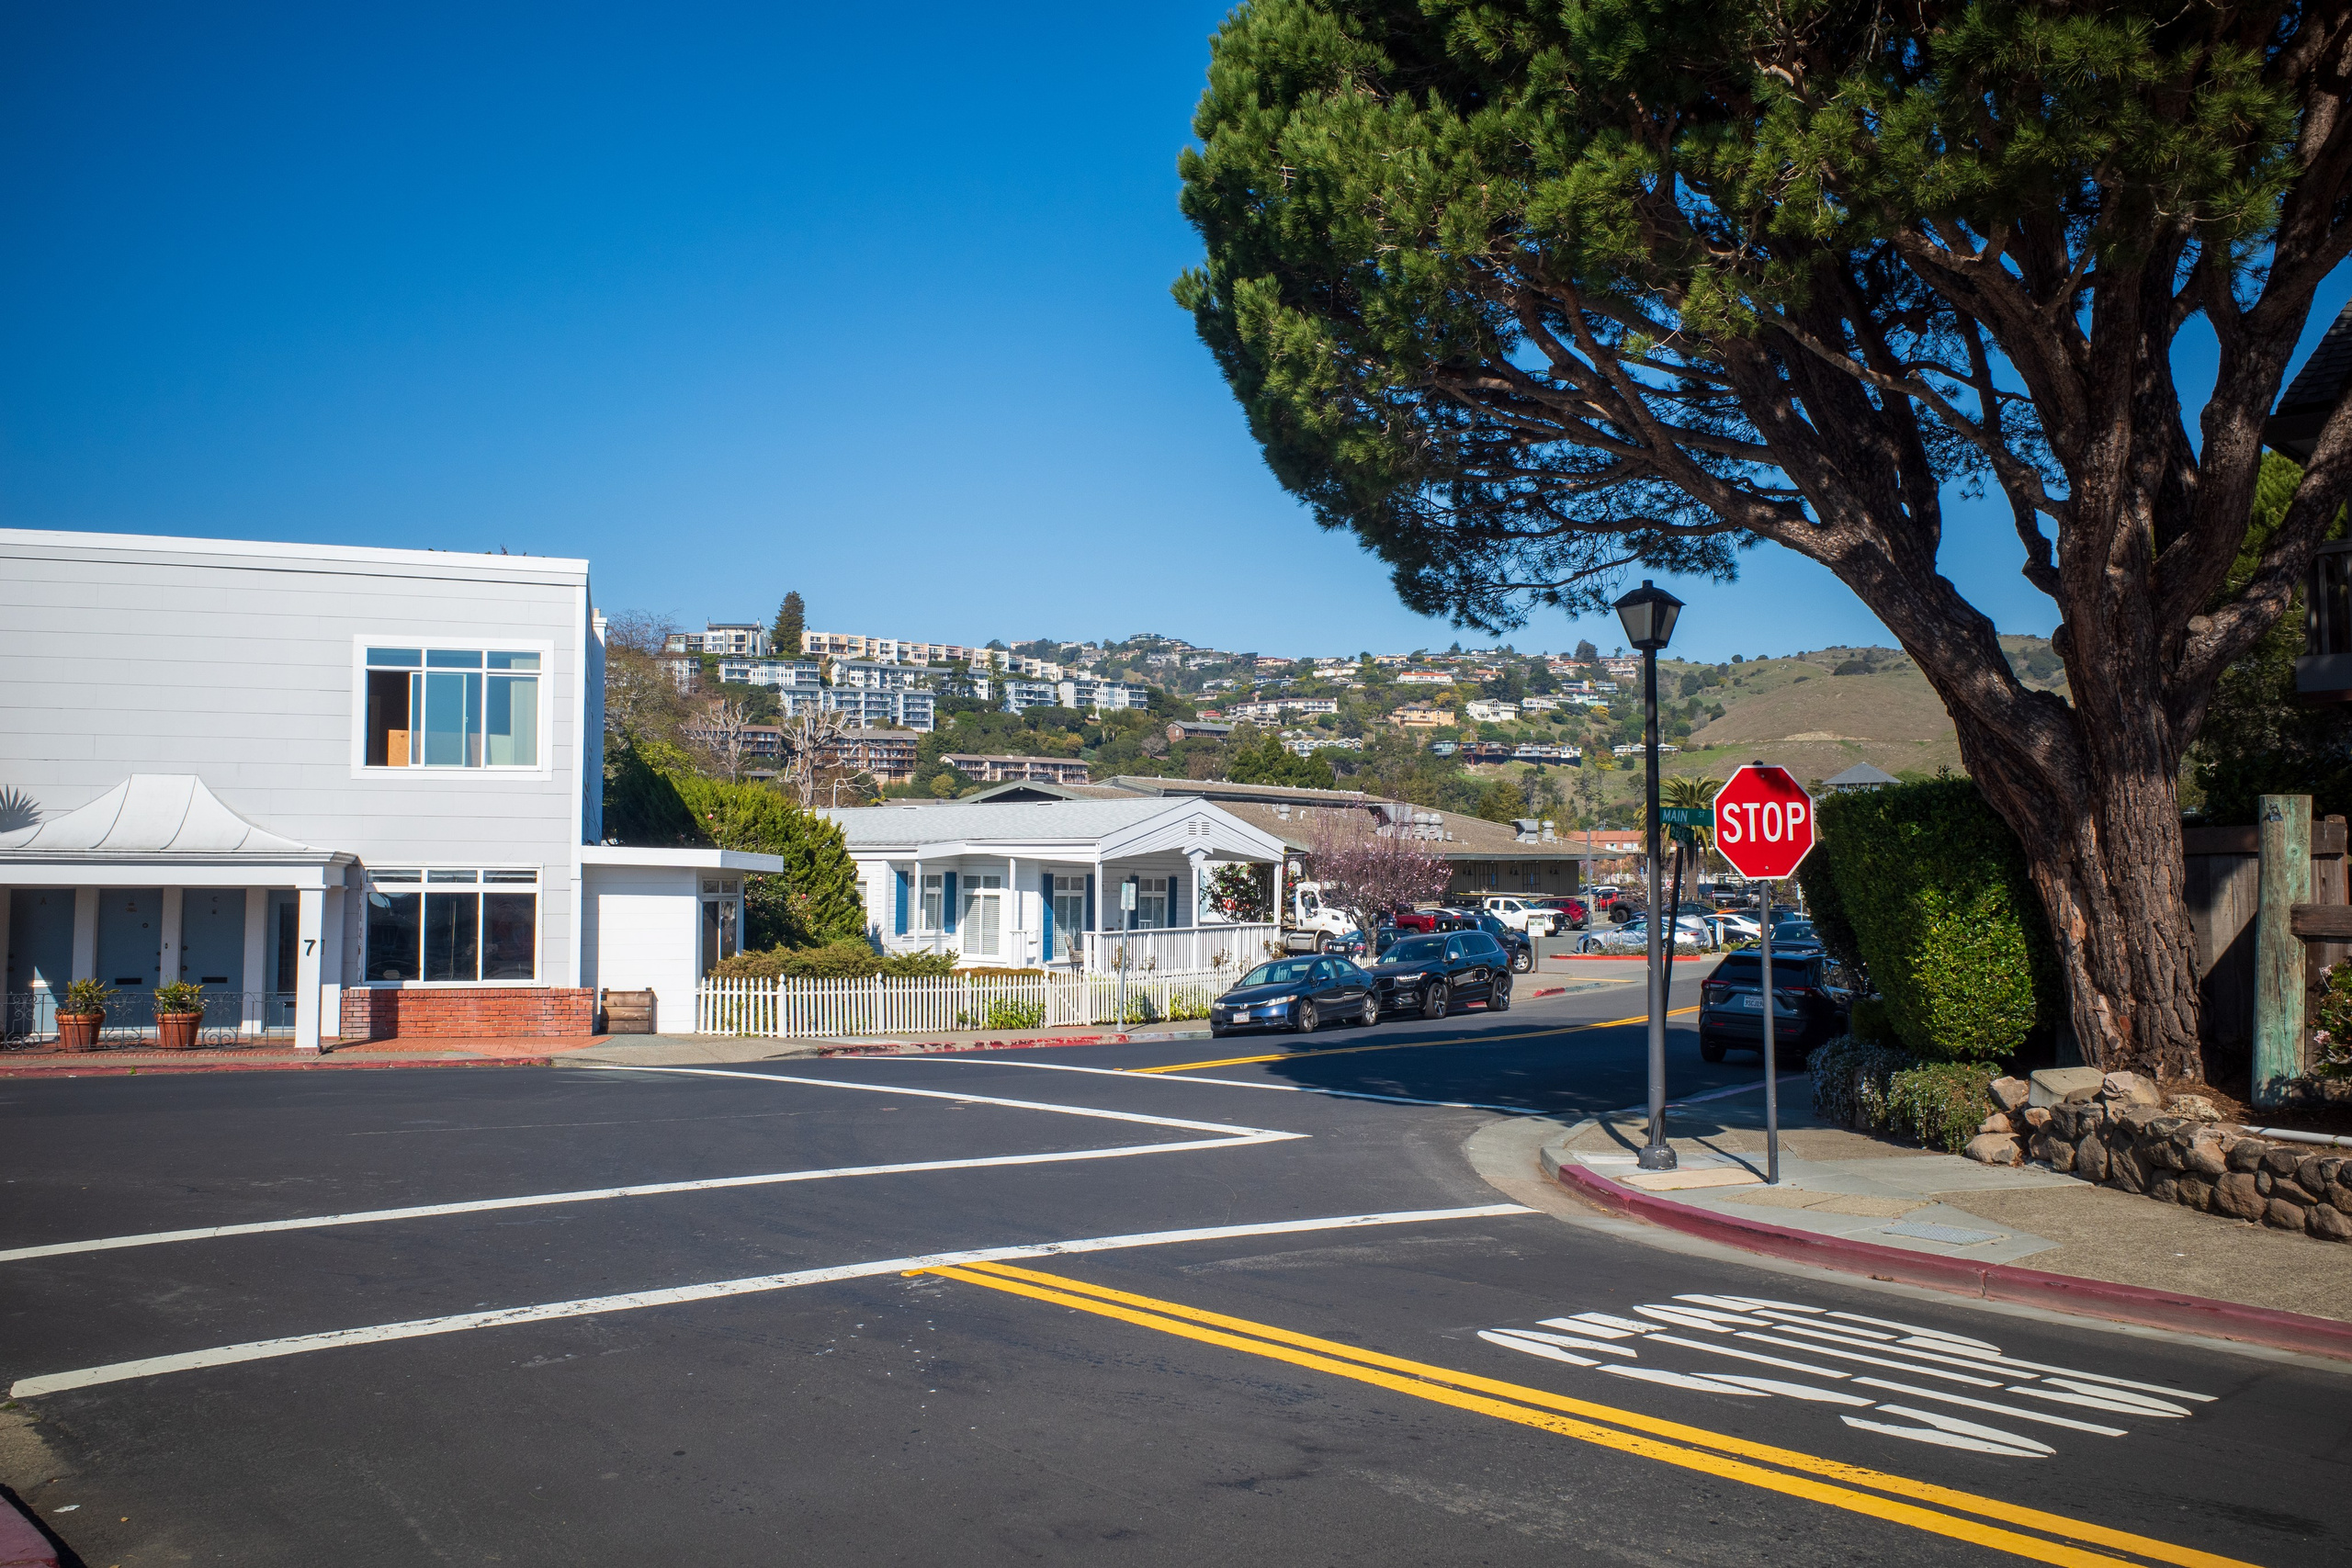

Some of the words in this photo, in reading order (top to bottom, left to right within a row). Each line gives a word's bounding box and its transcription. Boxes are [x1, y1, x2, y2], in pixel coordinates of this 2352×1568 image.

[1662, 809, 1689, 822] MAIN
[1698, 810, 1705, 818] ST
[1722, 801, 1806, 844] STOP
[304, 939, 317, 957] 7
[1477, 1293, 2220, 1458] STOP
